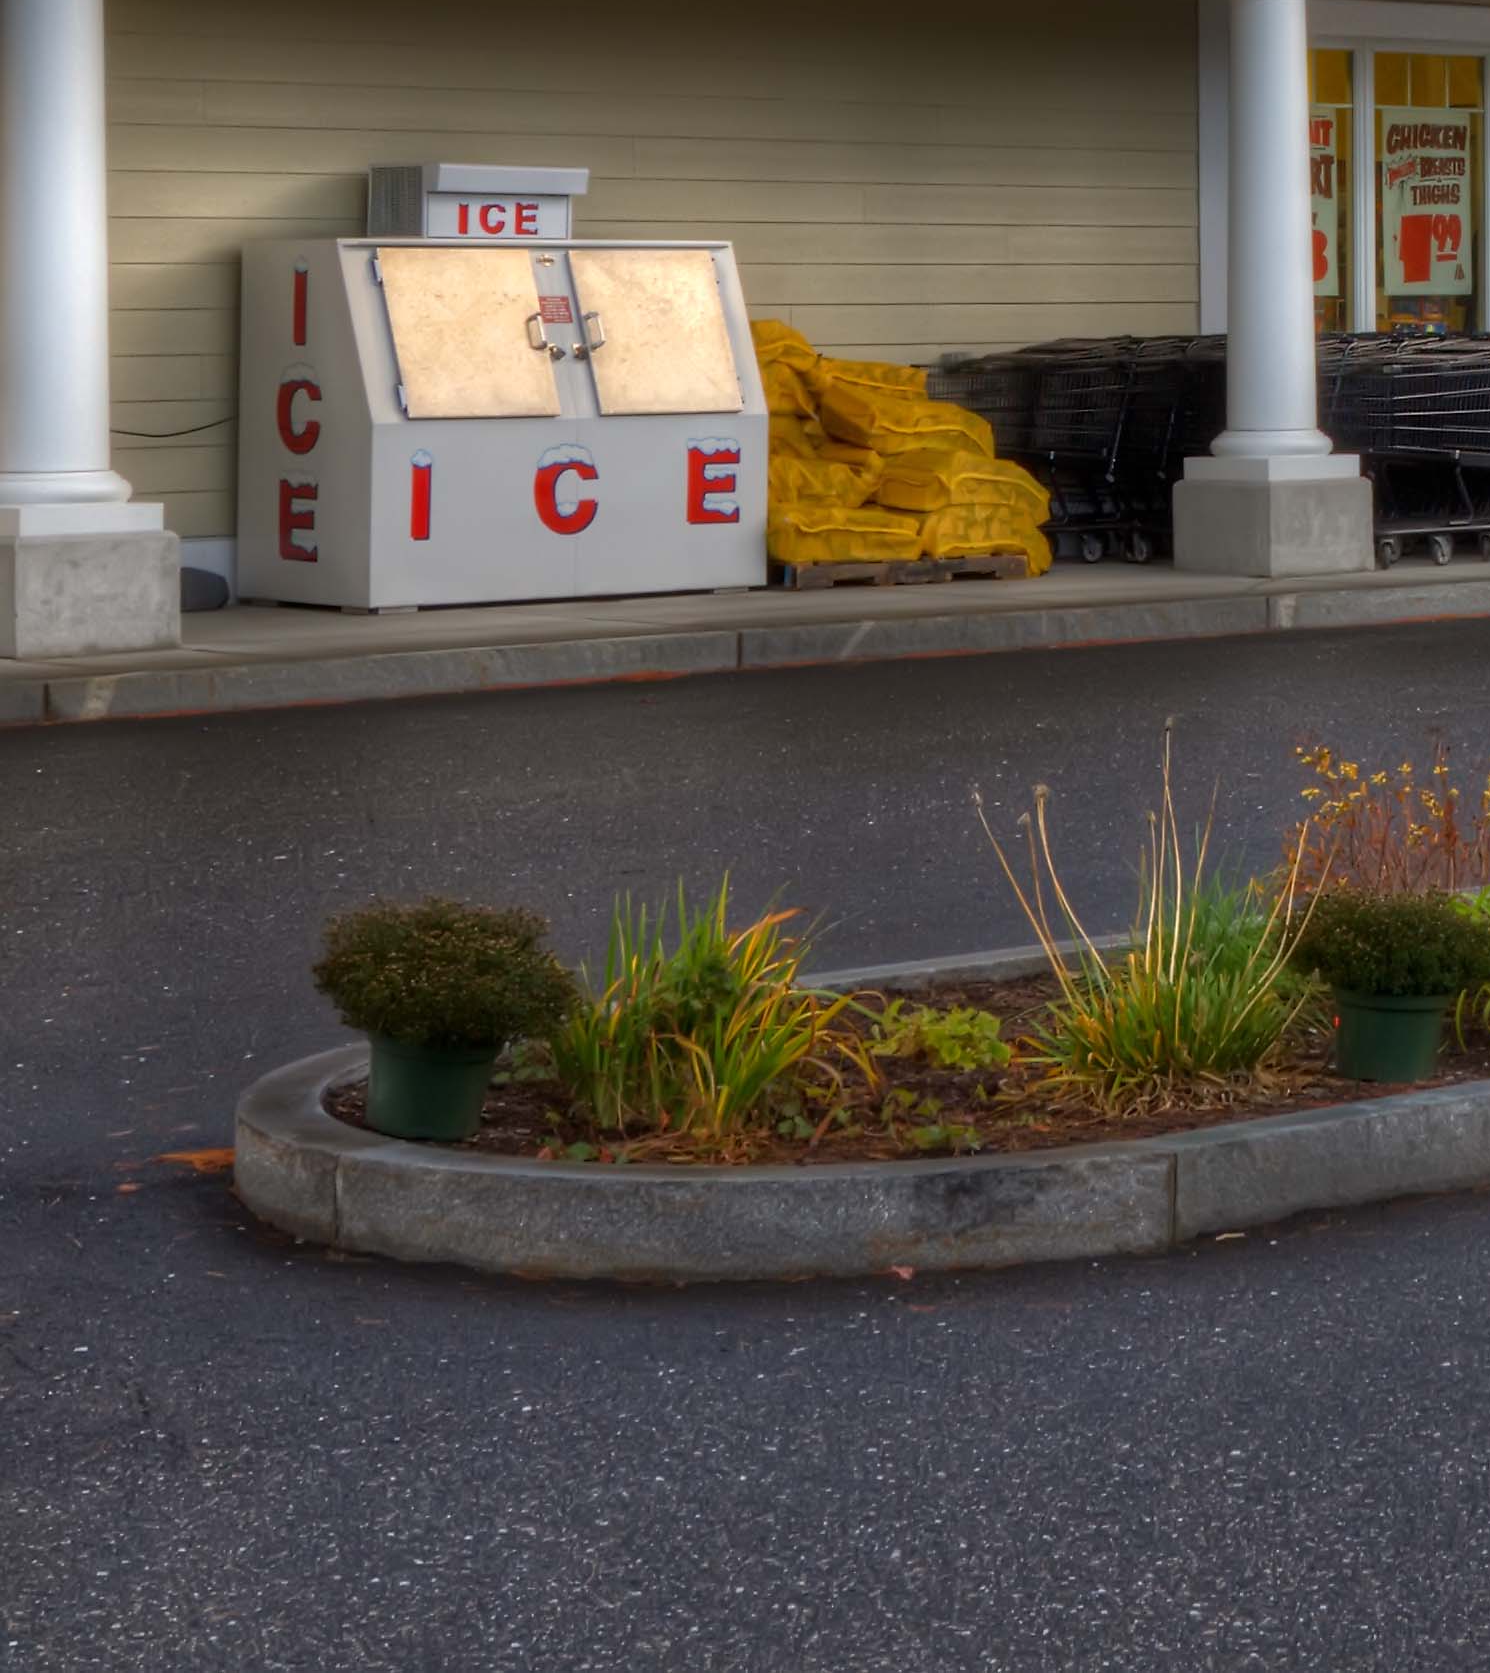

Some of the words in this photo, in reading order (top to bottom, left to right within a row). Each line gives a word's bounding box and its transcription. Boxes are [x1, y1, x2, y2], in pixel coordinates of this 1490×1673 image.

[1386, 123, 1468, 155] CHICKEN
[1419, 157, 1466, 177] BREASTS
[1410, 182, 1462, 207] THIGHS
[457, 202, 540, 236] ICE
